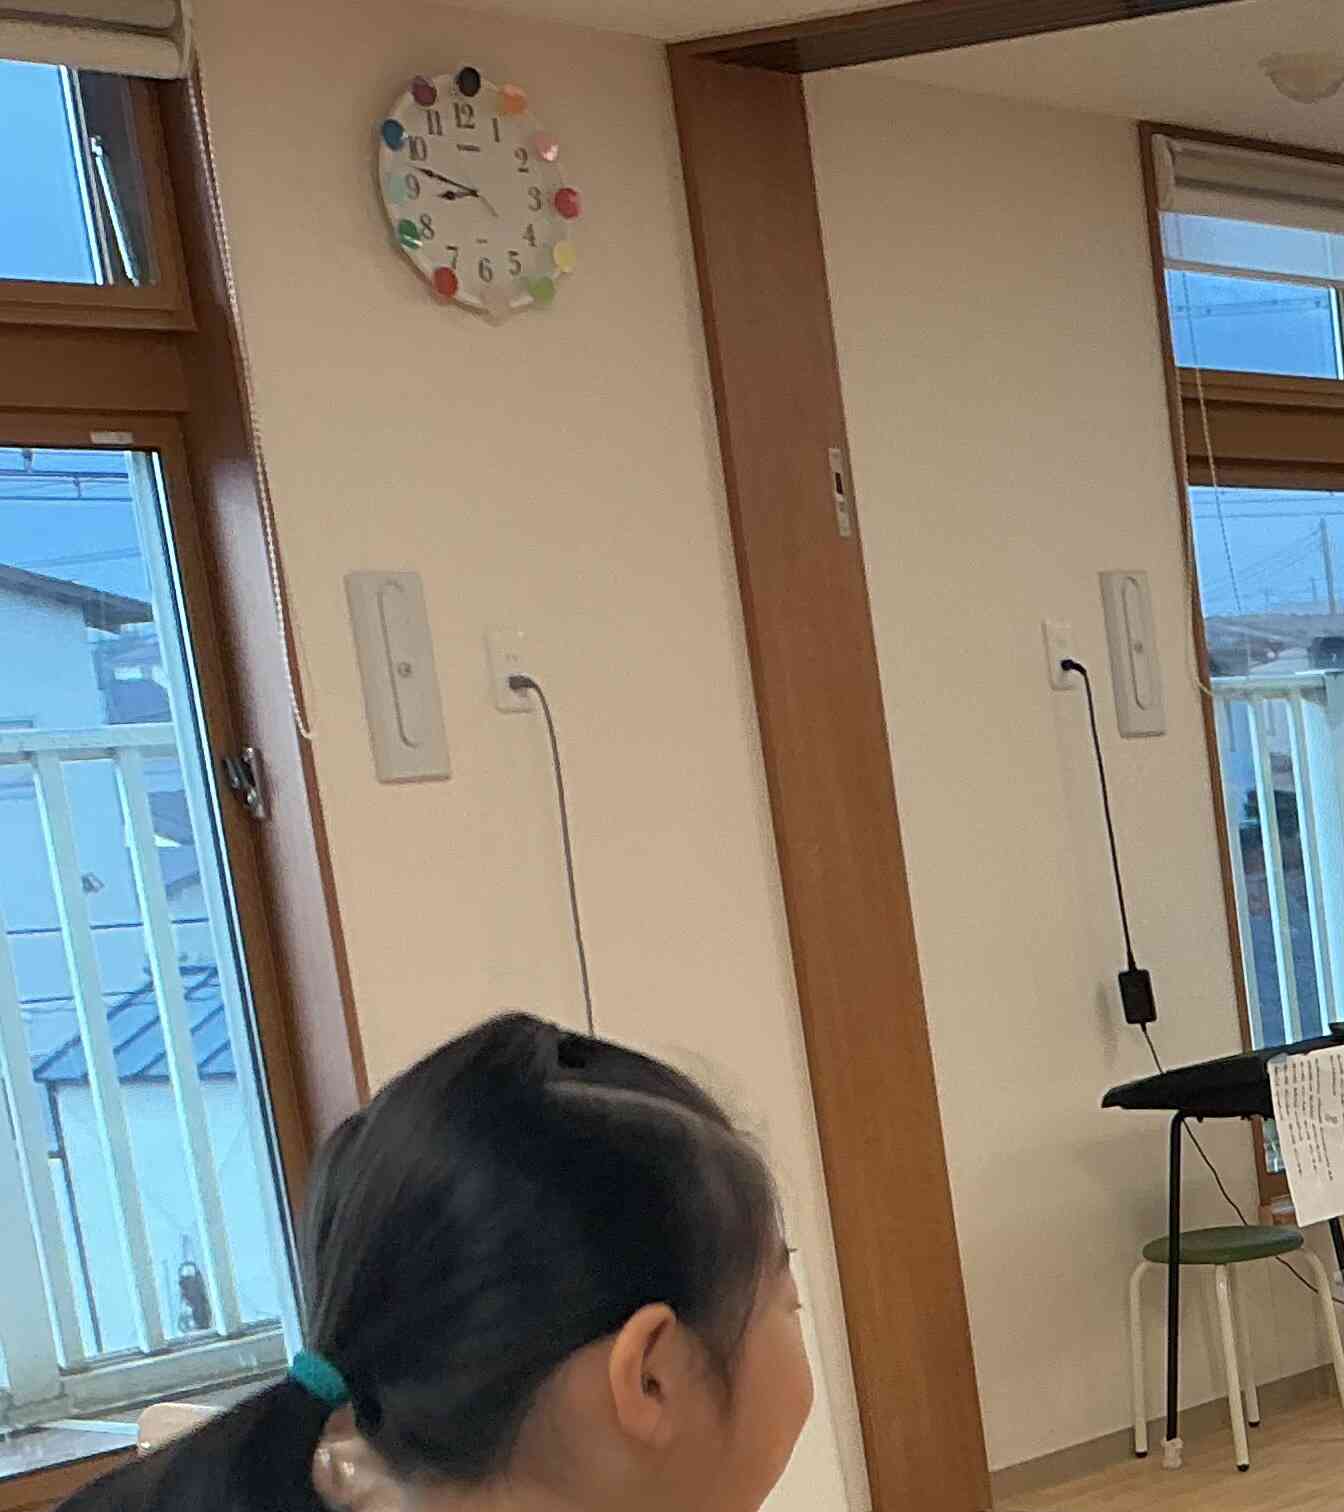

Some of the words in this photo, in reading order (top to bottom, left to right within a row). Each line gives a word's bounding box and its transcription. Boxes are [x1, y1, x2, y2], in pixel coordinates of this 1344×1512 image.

[426, 110, 444, 137] 11
[453, 102, 476, 129] 12
[491, 117, 501, 143] 1
[408, 135, 427, 161] 10
[513, 147, 529, 173] 2
[405, 174, 421, 199] 9
[528, 187, 543, 212] 3
[419, 214, 435, 240] 8
[522, 224, 537, 247] 4
[445, 246, 459, 270] 7
[478, 258, 493, 282] 6
[507, 251, 522, 275] 5
